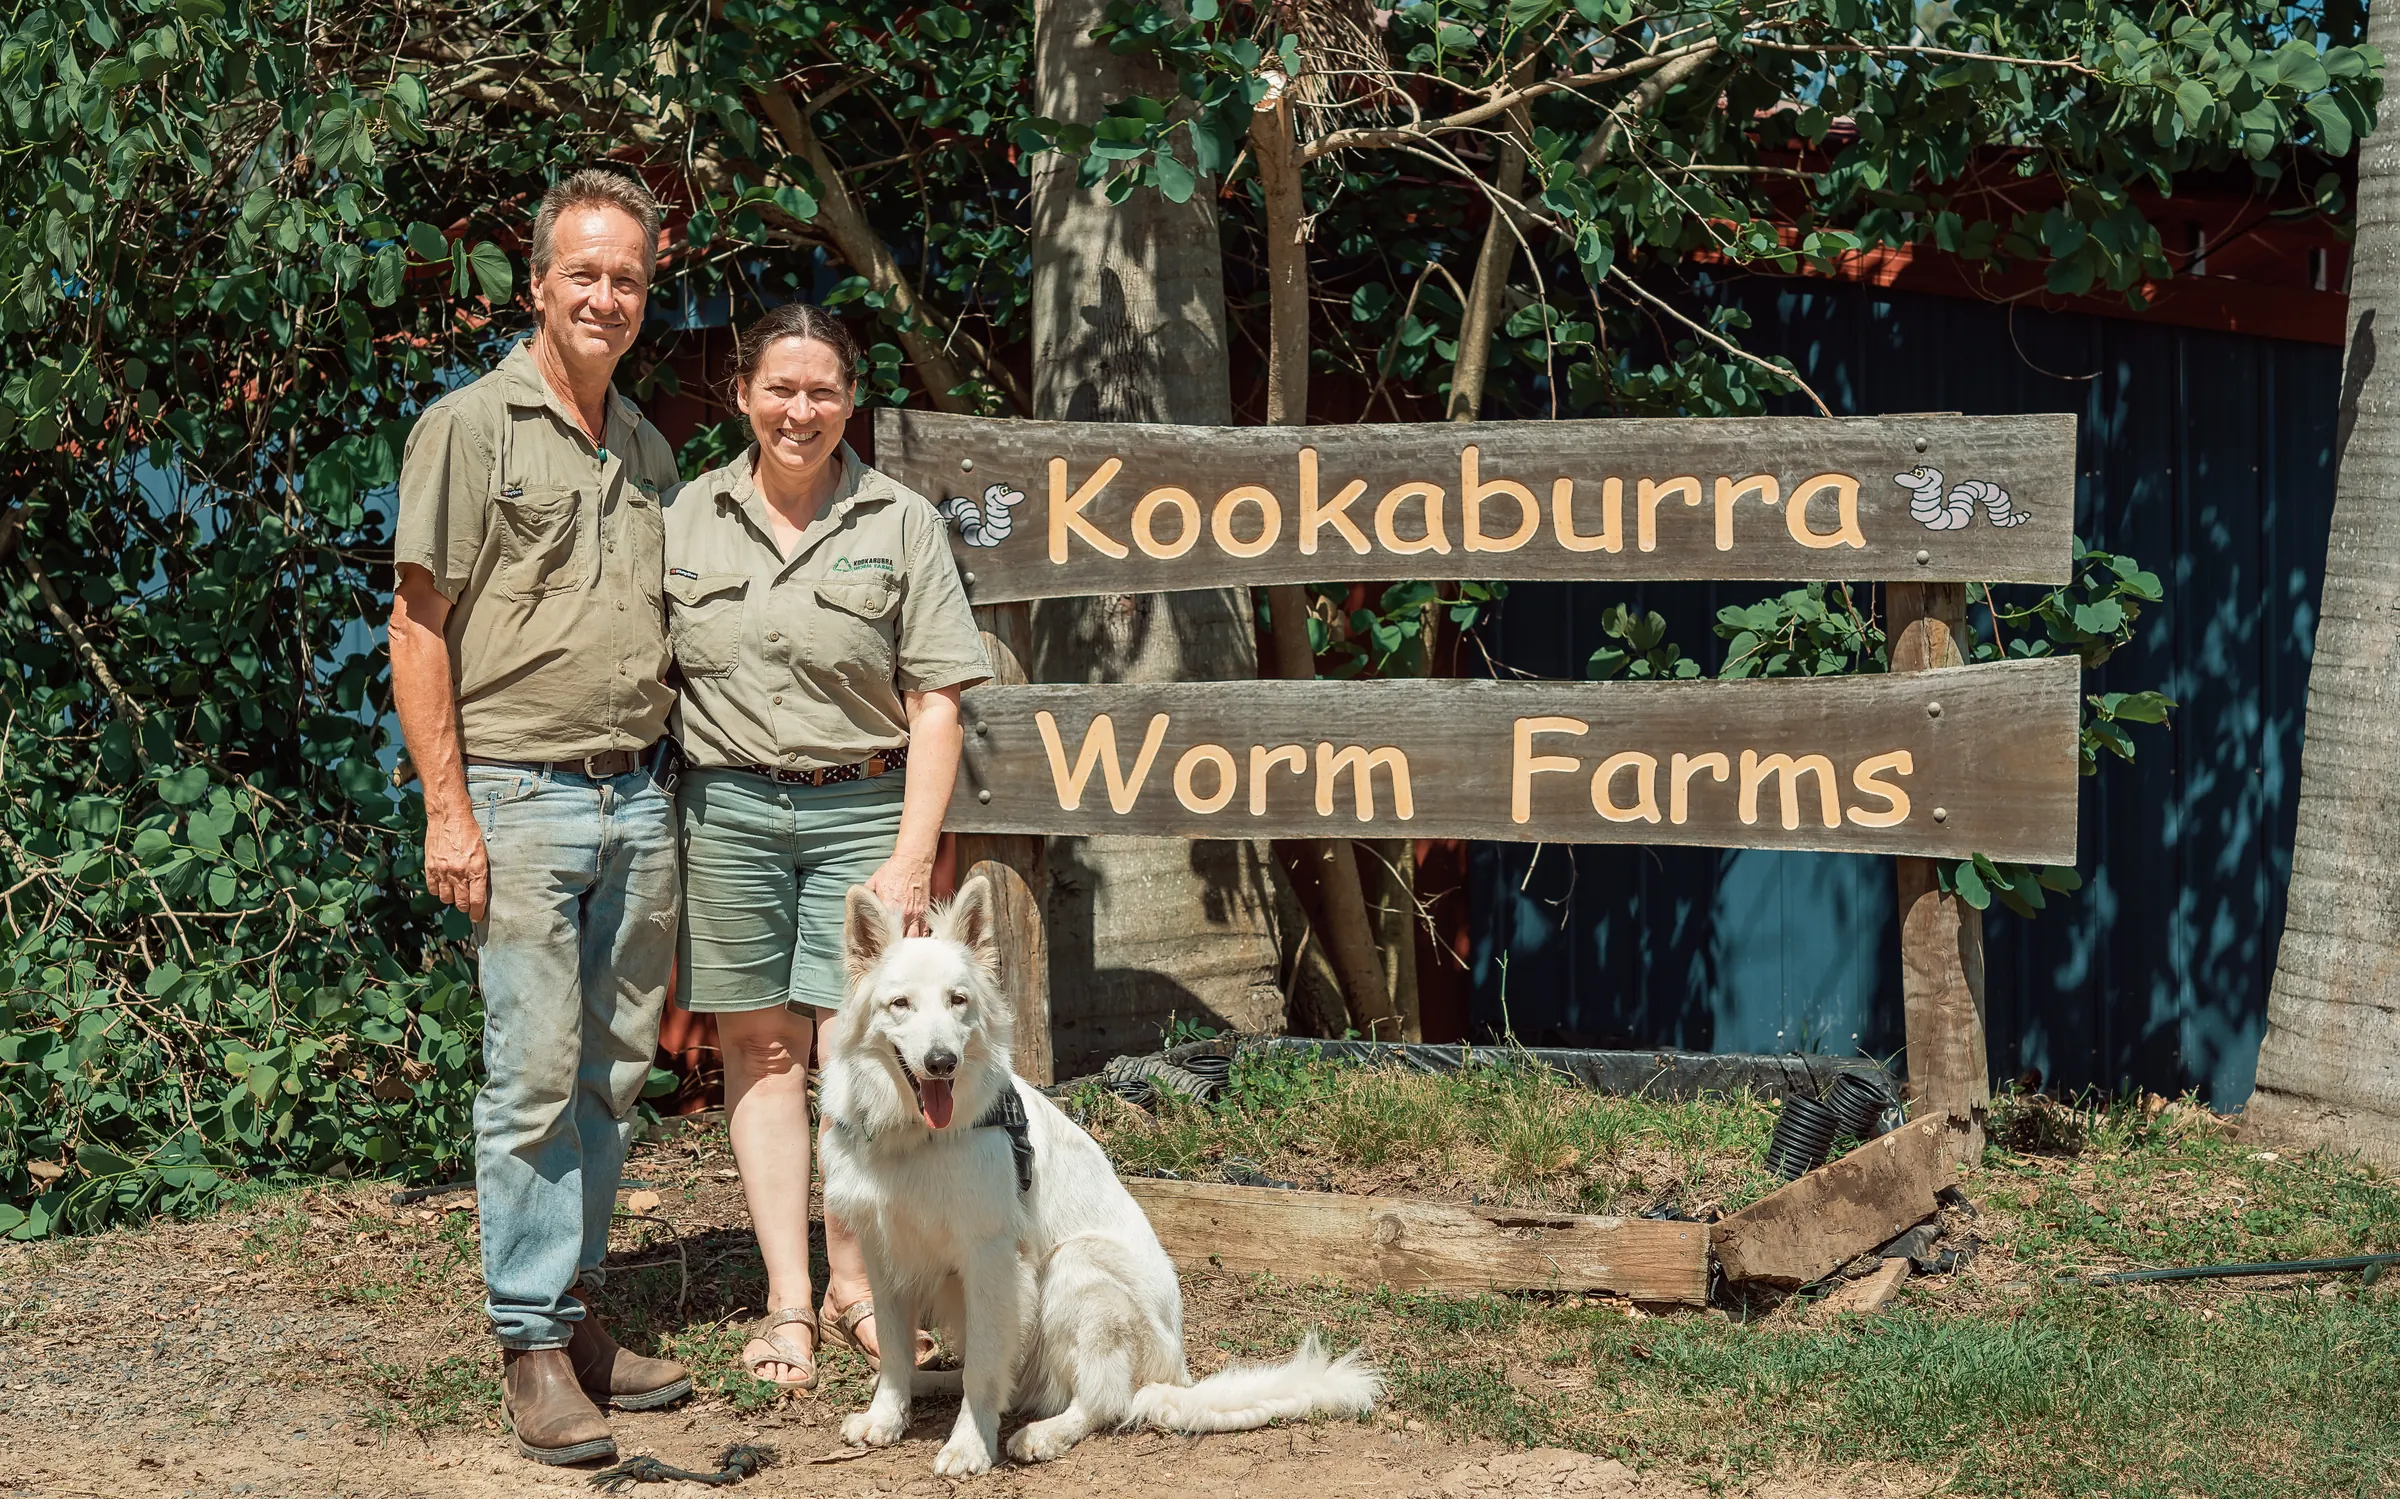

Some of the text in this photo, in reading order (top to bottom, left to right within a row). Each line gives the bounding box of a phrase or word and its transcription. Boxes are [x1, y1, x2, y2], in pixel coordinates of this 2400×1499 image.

[1048, 446, 1866, 563] Kookaburra
[1034, 711, 1915, 829] Worm Farms
